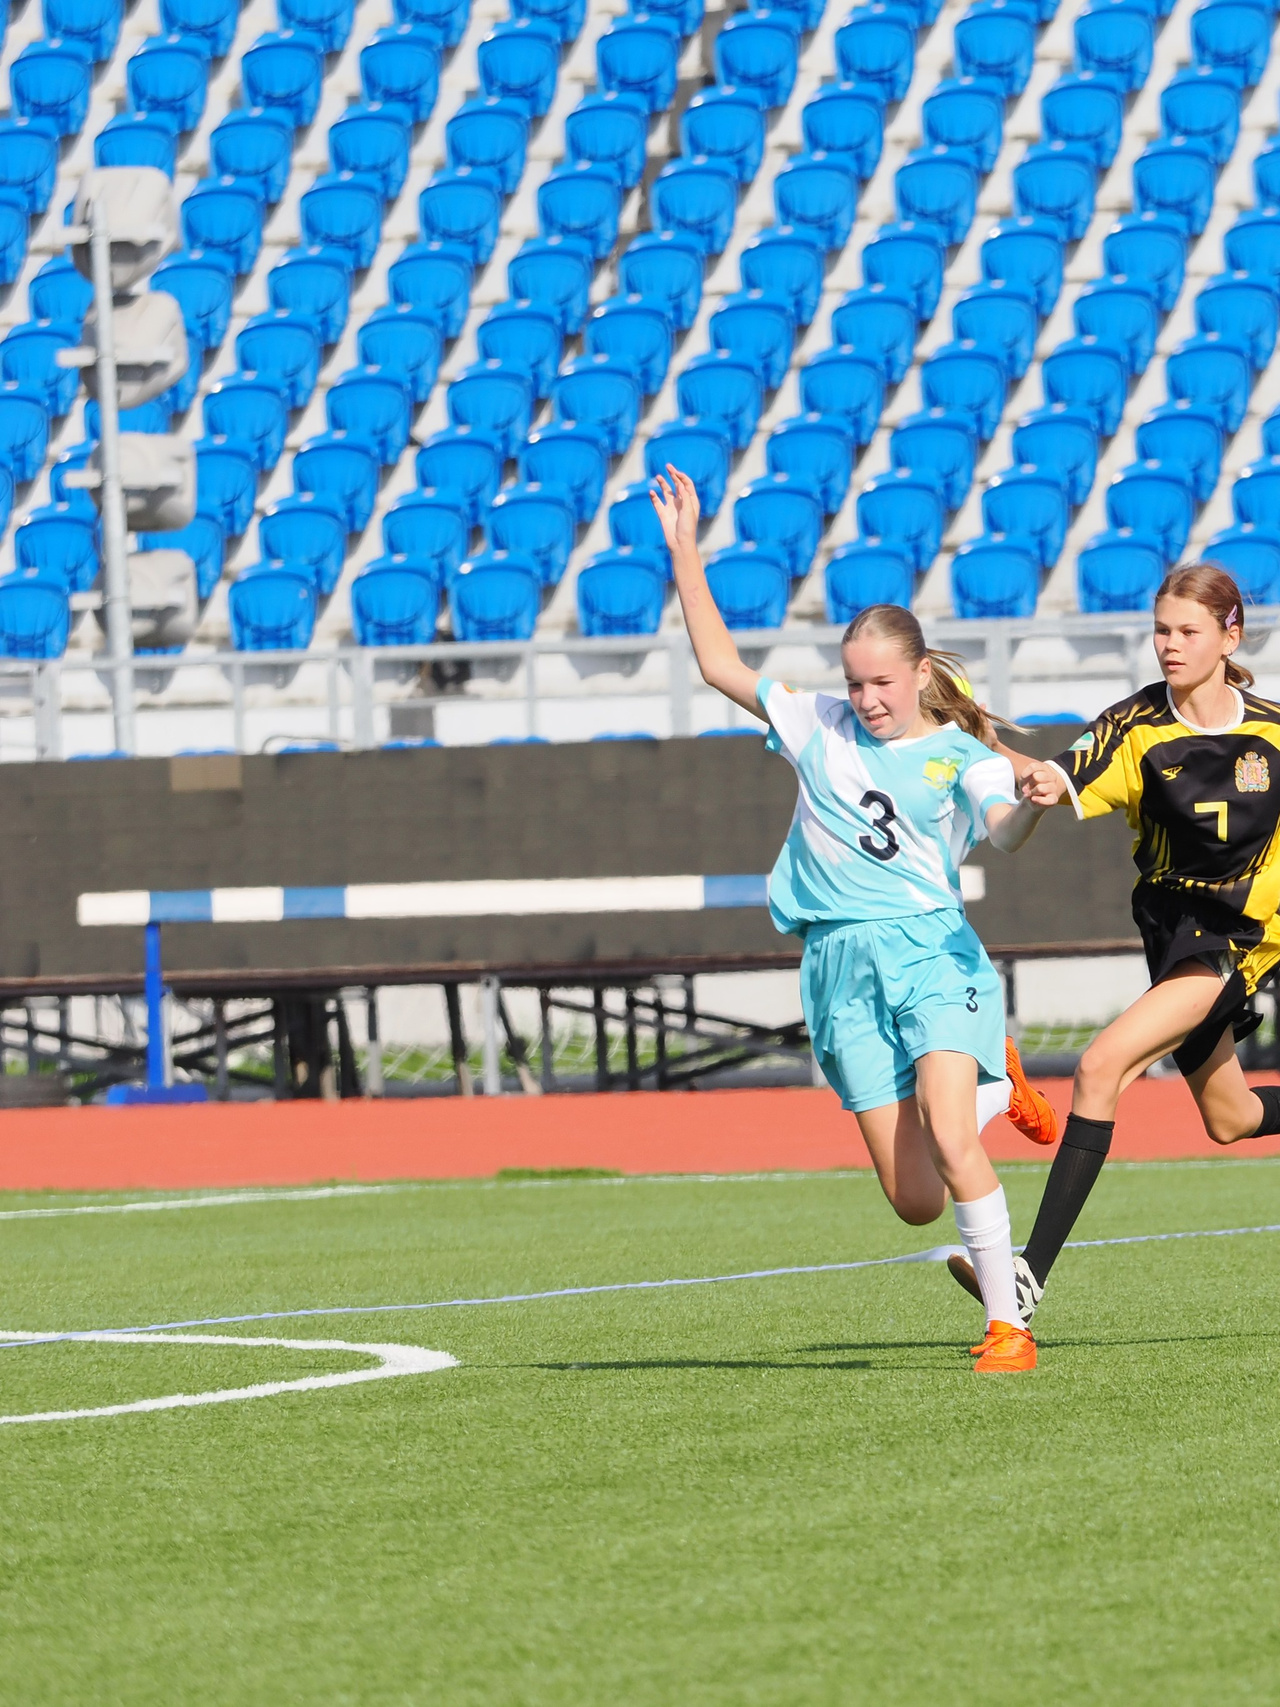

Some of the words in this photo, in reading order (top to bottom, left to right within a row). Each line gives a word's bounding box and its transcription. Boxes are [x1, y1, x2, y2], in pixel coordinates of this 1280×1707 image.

[859, 790, 899, 861] 3
[1194, 801, 1228, 842] 7
[965, 986, 979, 1013] 3
